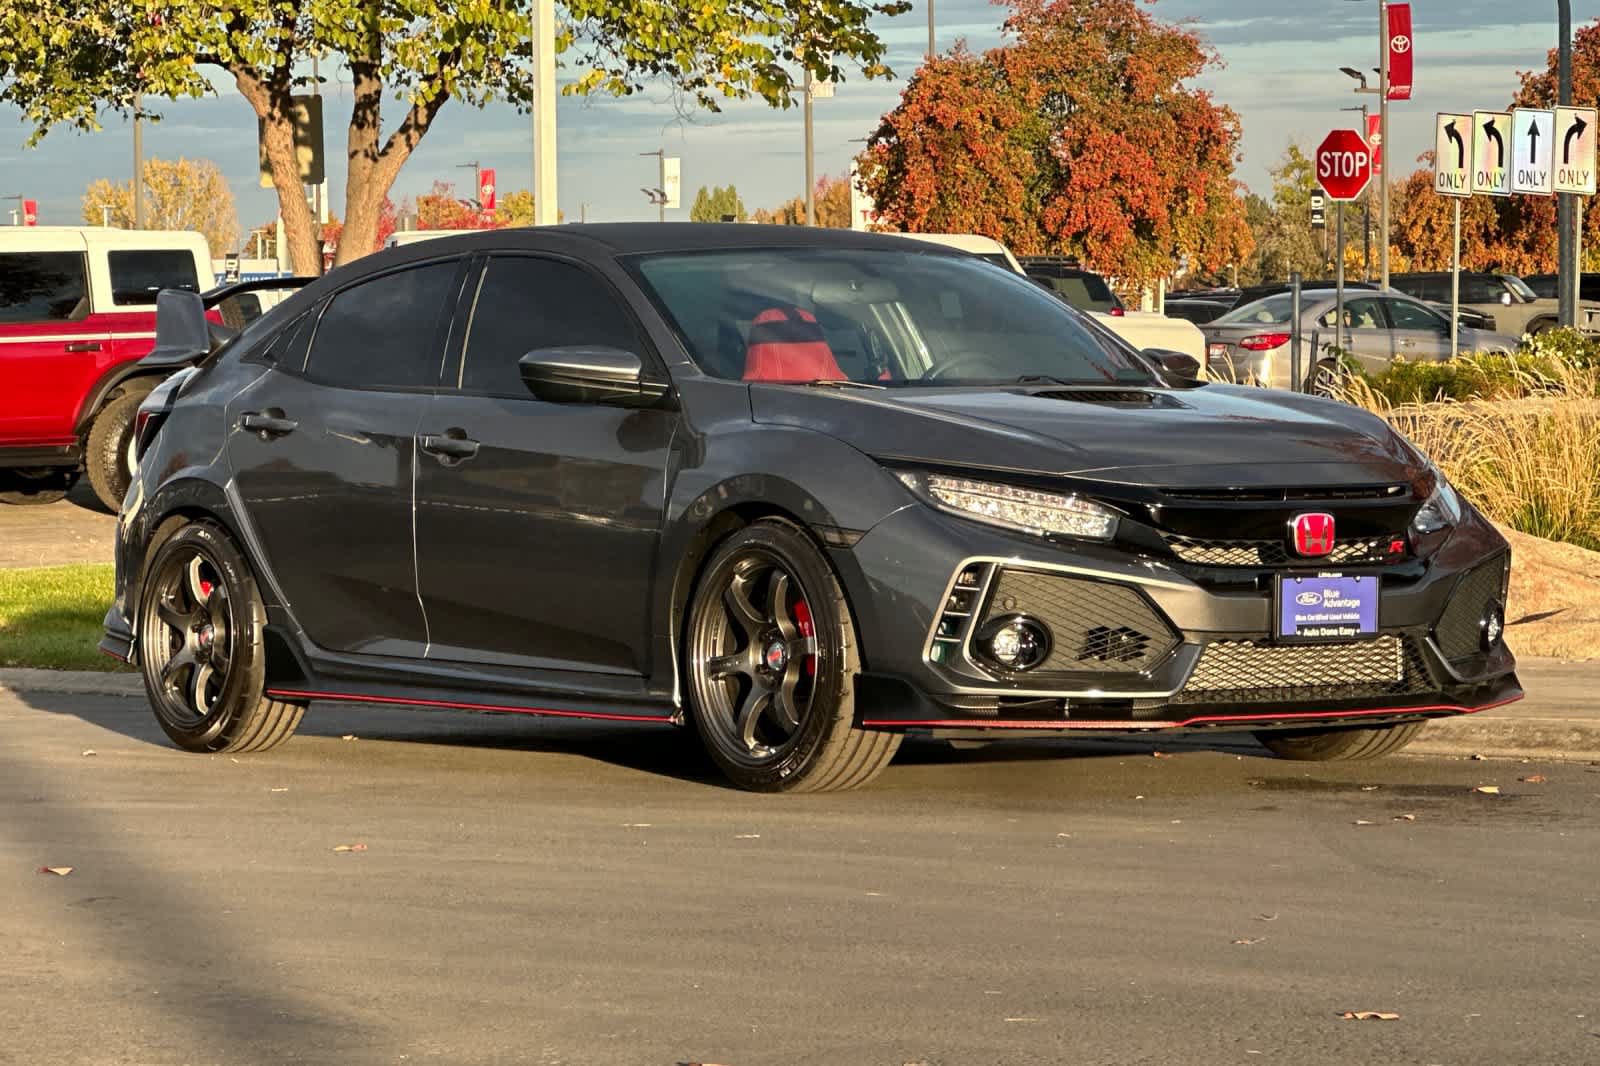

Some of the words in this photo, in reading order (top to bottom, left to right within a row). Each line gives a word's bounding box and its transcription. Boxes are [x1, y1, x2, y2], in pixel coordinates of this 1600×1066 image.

[1320, 151, 1367, 177] STOP
[1439, 172, 1466, 189] ONLY
[1477, 171, 1506, 189] ONLY
[1518, 169, 1546, 186] ONLY
[1559, 168, 1589, 186] ONLY
[1323, 589, 1340, 598] Blue
[1323, 598, 1361, 608] Advantage
